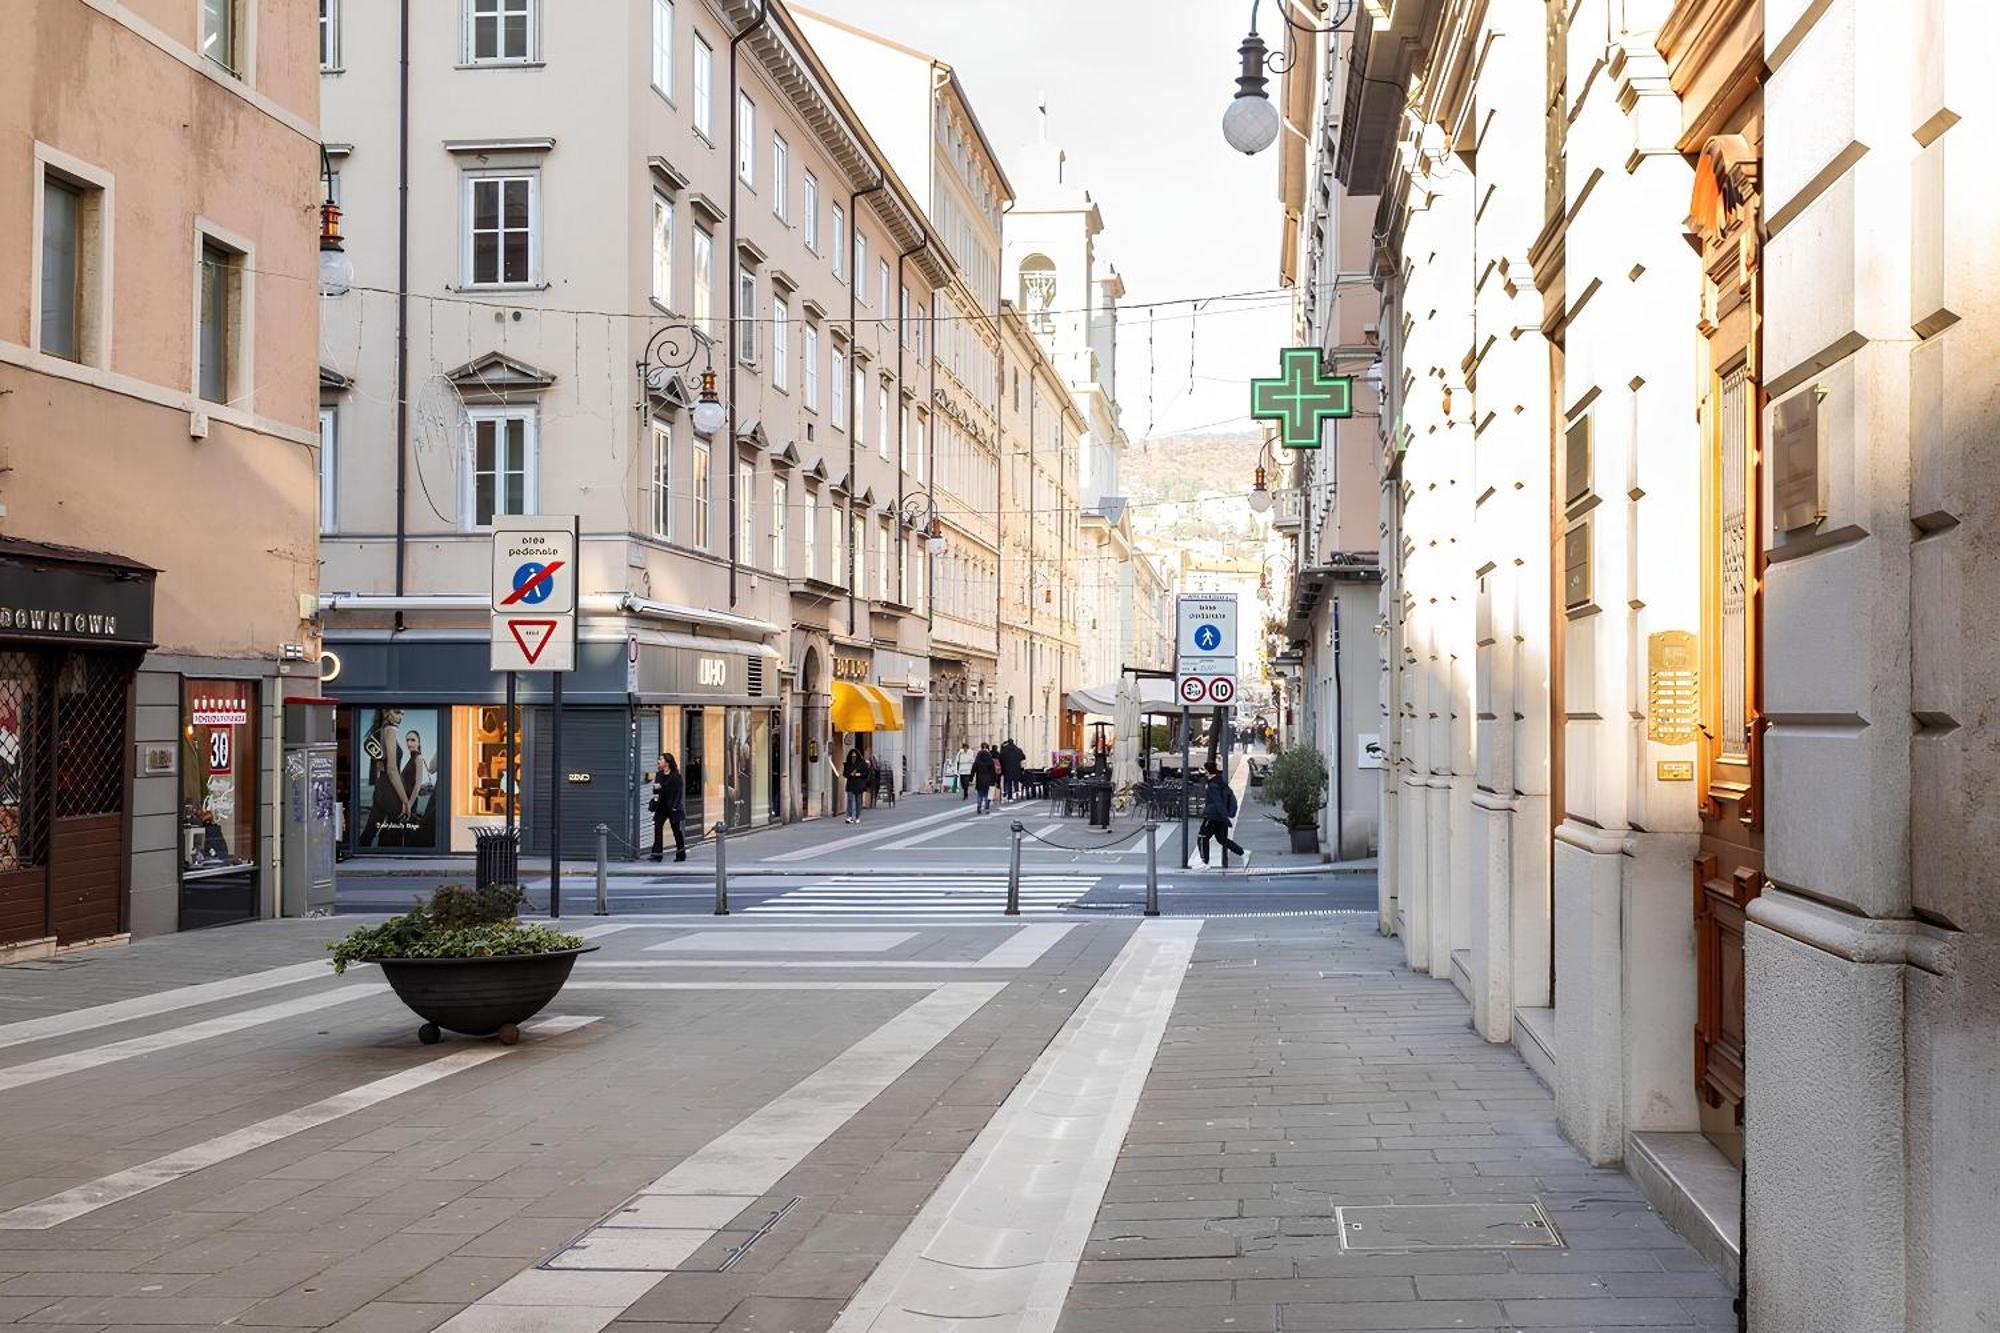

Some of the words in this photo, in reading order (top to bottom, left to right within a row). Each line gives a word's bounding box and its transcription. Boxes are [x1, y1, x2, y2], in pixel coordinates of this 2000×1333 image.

[0, 607, 116, 635] DOWNTOWN
[1215, 684, 1228, 697] 10
[210, 731, 229, 768] 30
